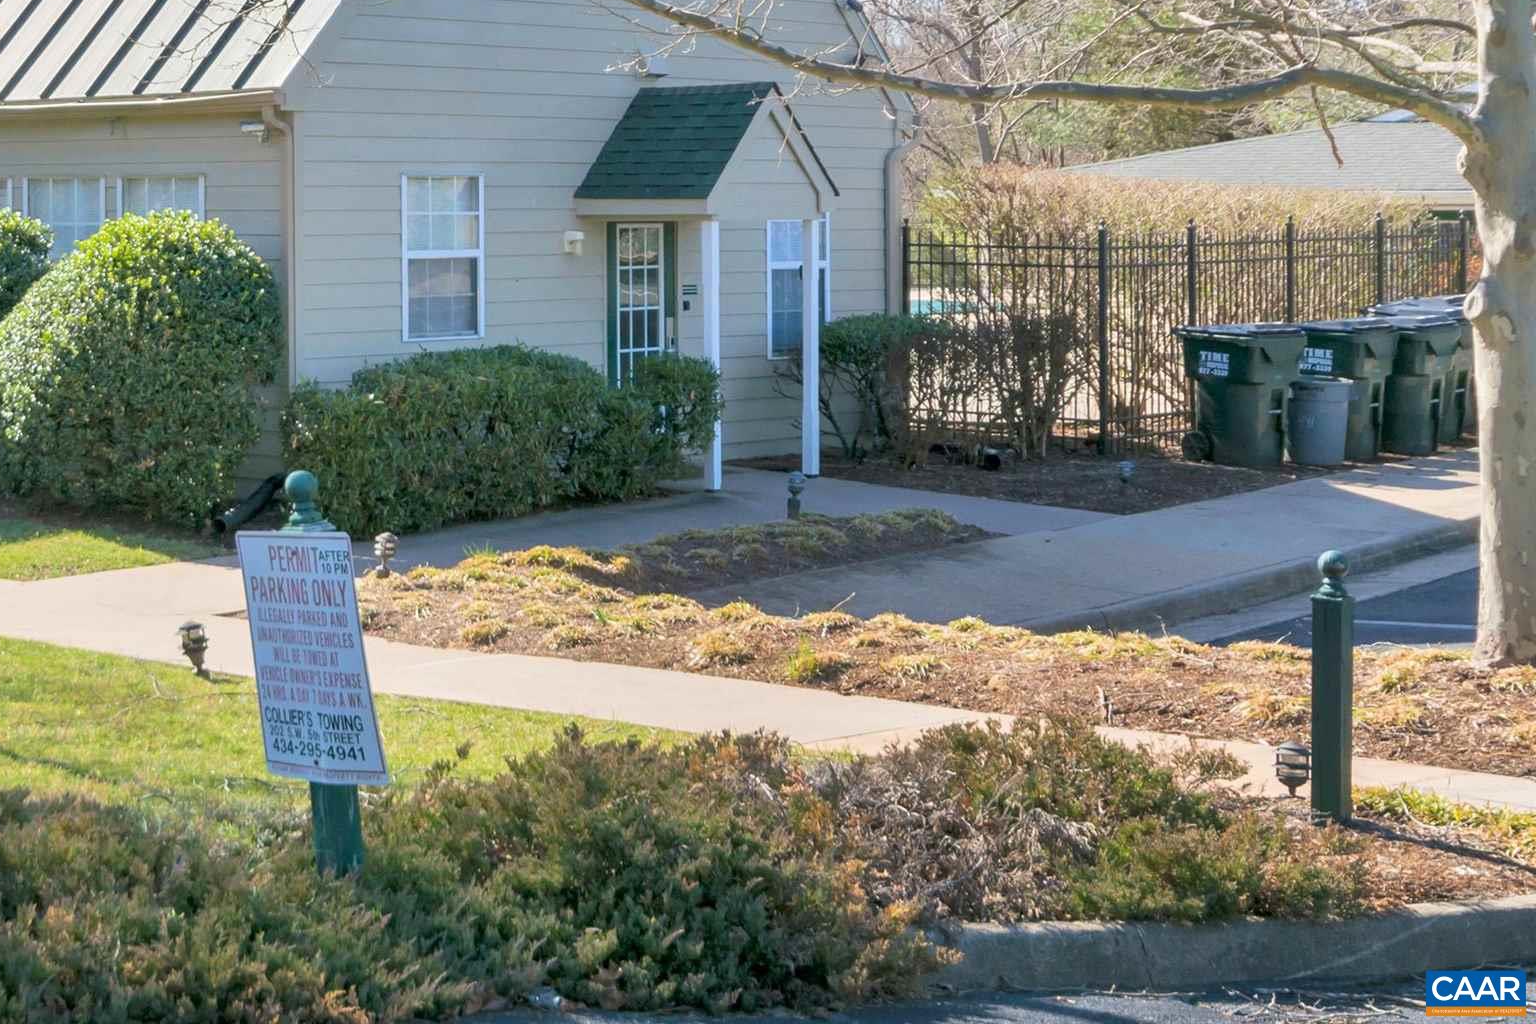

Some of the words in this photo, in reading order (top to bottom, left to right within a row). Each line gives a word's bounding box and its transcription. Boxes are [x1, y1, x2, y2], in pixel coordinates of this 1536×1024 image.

[1199, 350, 1230, 363] TIME
[268, 545, 319, 574] PERMIT
[319, 550, 349, 562] AFTER
[321, 563, 332, 574] 10
[334, 563, 349, 574] PM
[251, 576, 309, 606] PARKING
[312, 579, 346, 608] ONLY
[257, 607, 295, 624] ILLEGALLY
[297, 609, 328, 627] PARKED
[330, 612, 348, 628] AND
[315, 630, 354, 649] VEHICLES
[273, 646, 290, 663] WILL
[292, 647, 302, 664] BE
[303, 648, 328, 667] TOWED
[330, 651, 339, 668] AT
[324, 671, 362, 689] EXPENSE
[264, 705, 313, 728] COLLIER'S
[317, 712, 364, 732] TOWING
[323, 731, 361, 744] STREET
